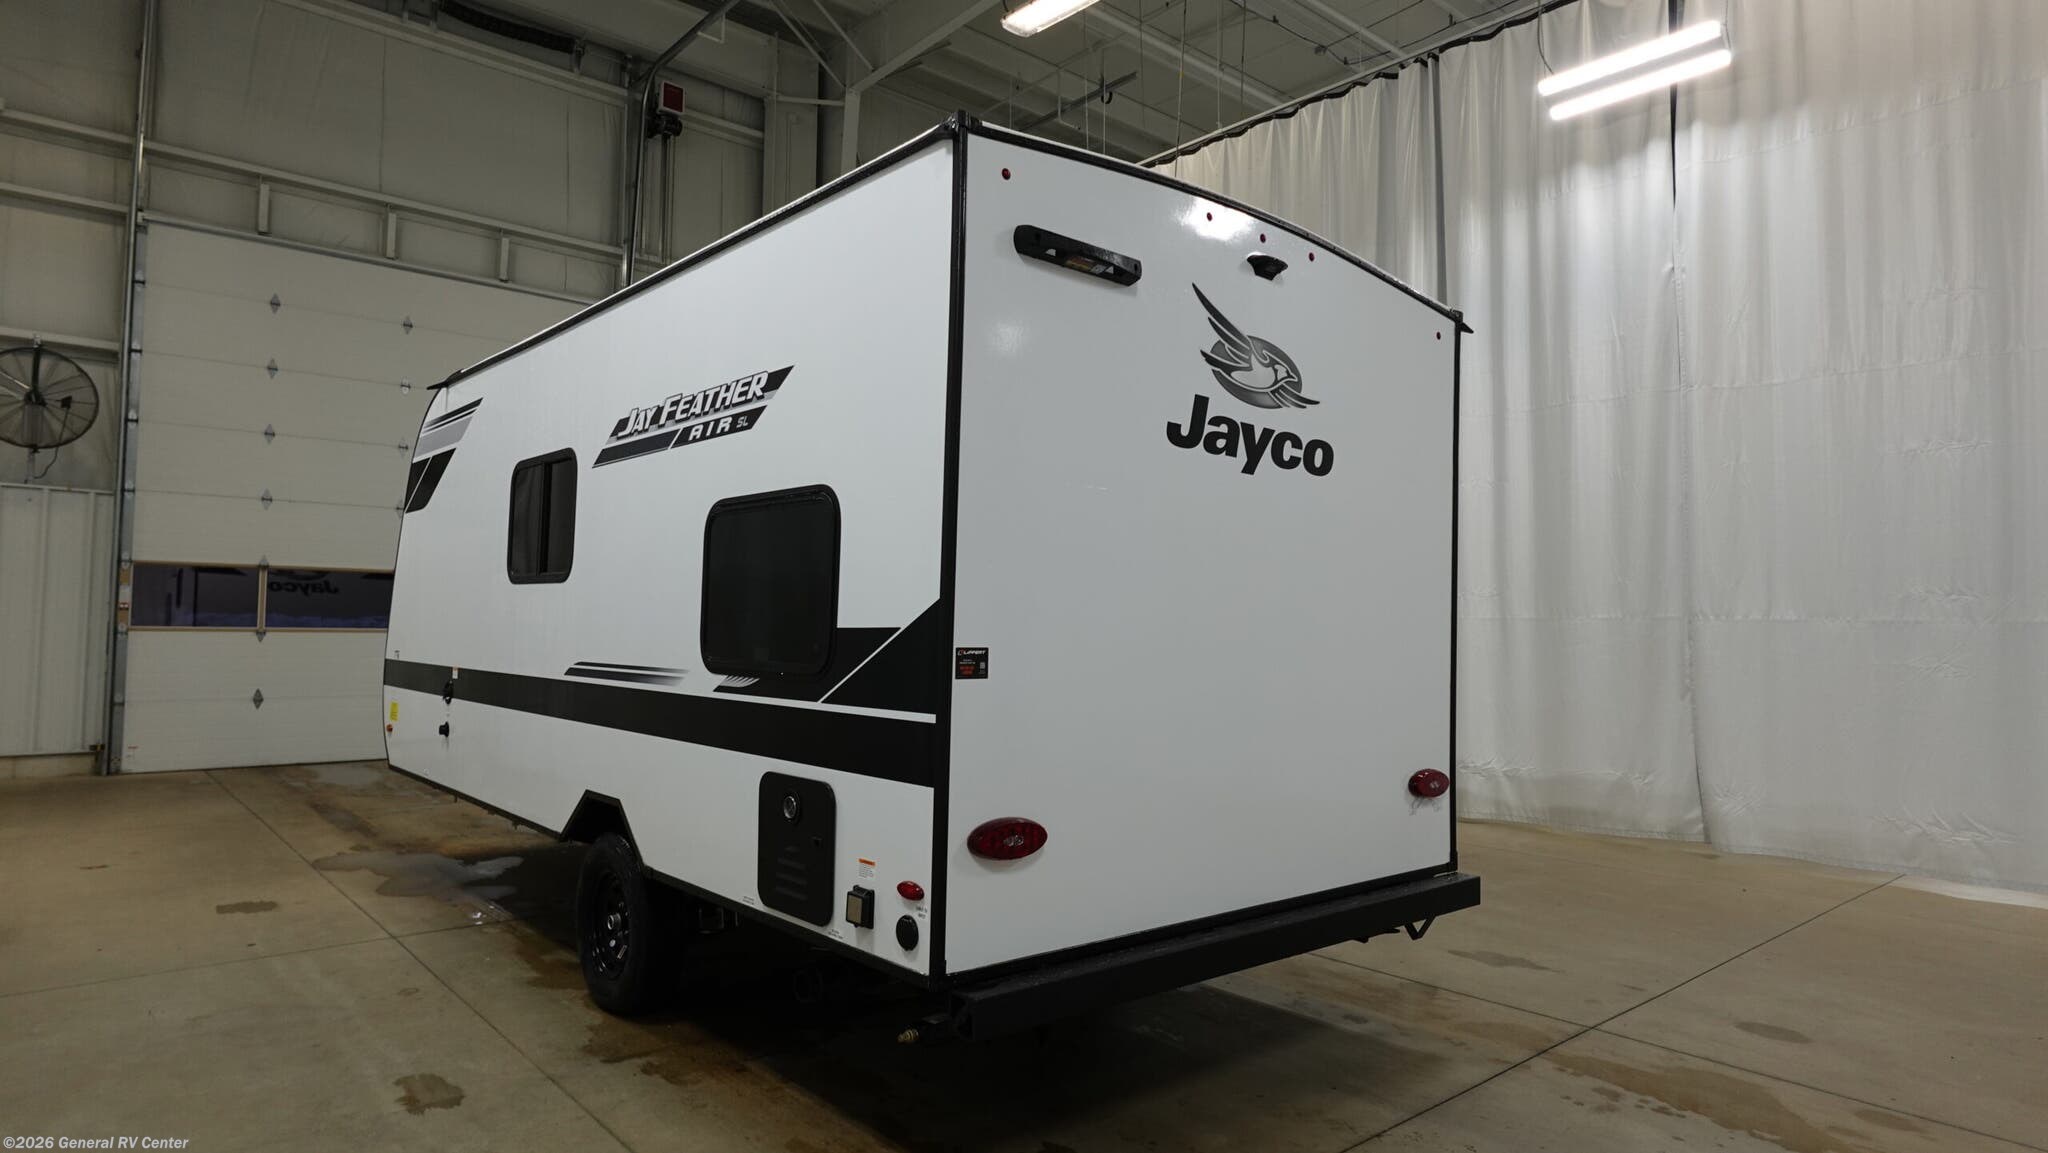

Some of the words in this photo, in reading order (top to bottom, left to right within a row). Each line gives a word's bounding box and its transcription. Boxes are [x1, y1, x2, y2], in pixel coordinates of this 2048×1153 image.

[617, 407, 660, 439] JAY
[658, 371, 769, 428] FEATHER
[688, 416, 733, 441] AIR
[736, 415, 749, 429] SL
[1166, 394, 1335, 476] Jayco
